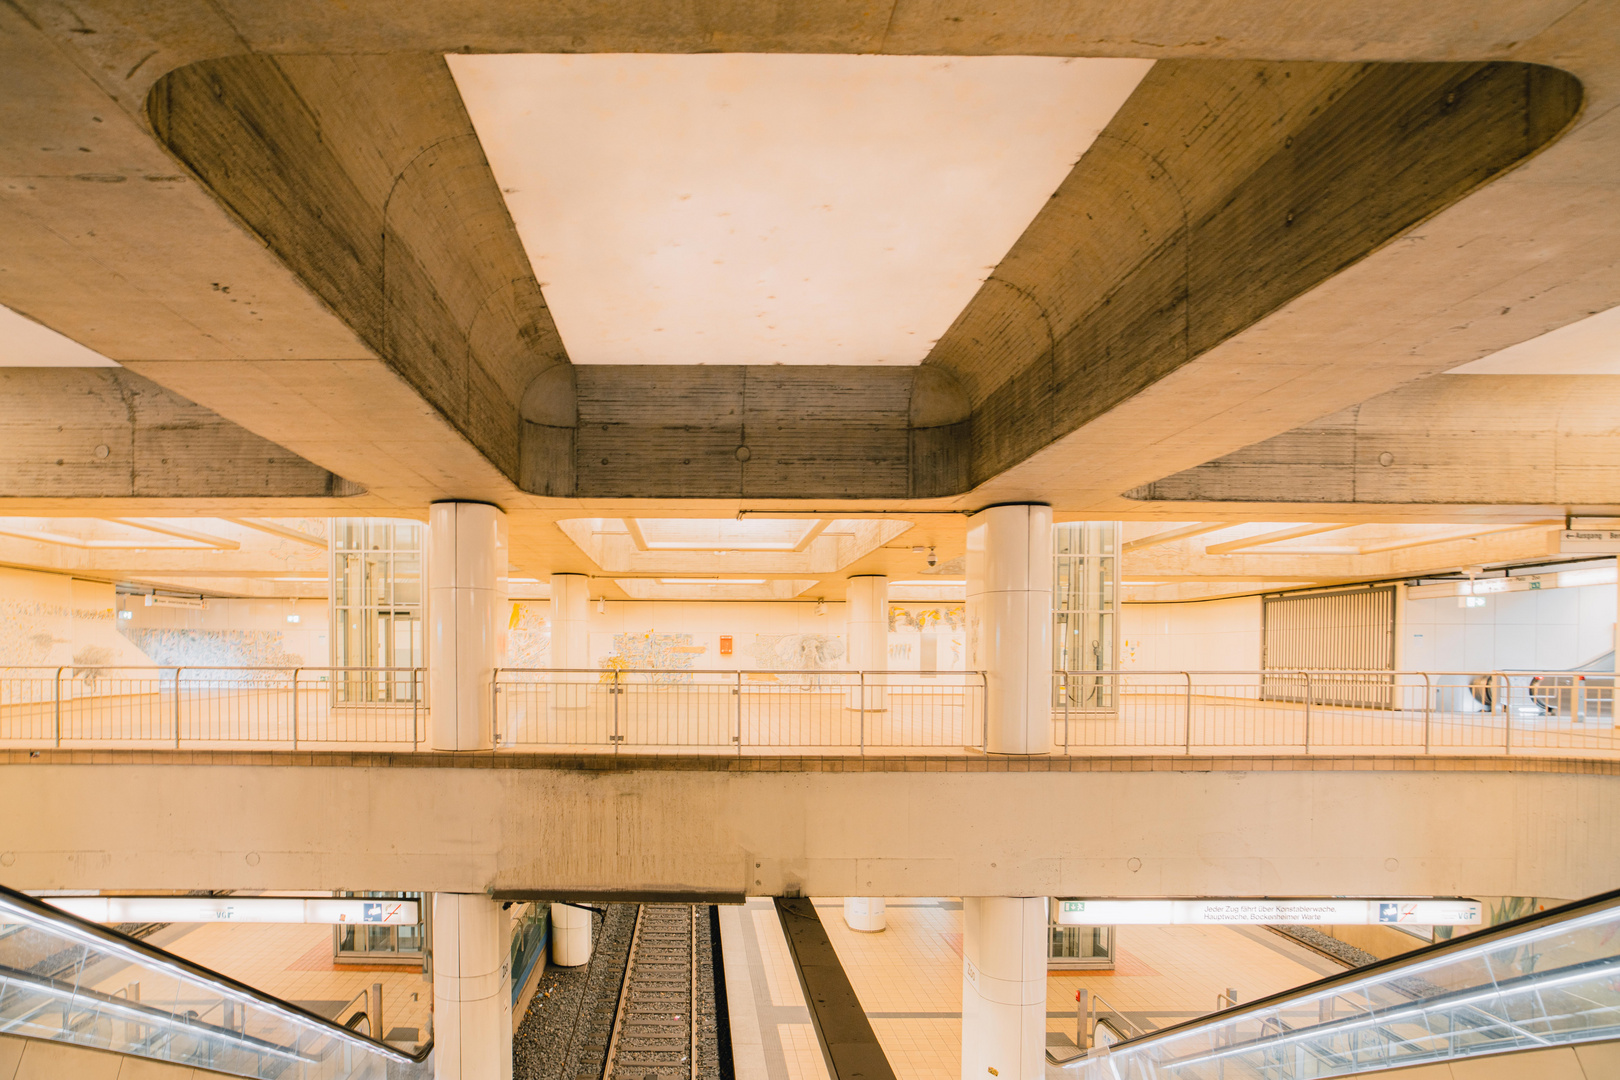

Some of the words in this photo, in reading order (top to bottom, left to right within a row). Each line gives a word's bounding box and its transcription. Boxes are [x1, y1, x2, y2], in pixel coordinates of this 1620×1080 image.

[217, 907, 234, 919] VGF
[1225, 906, 1239, 914] Zug
[1275, 906, 1337, 914] Konstablerwache,
[1458, 907, 1476, 919] VGF
[968, 963, 976, 981] Zoo
